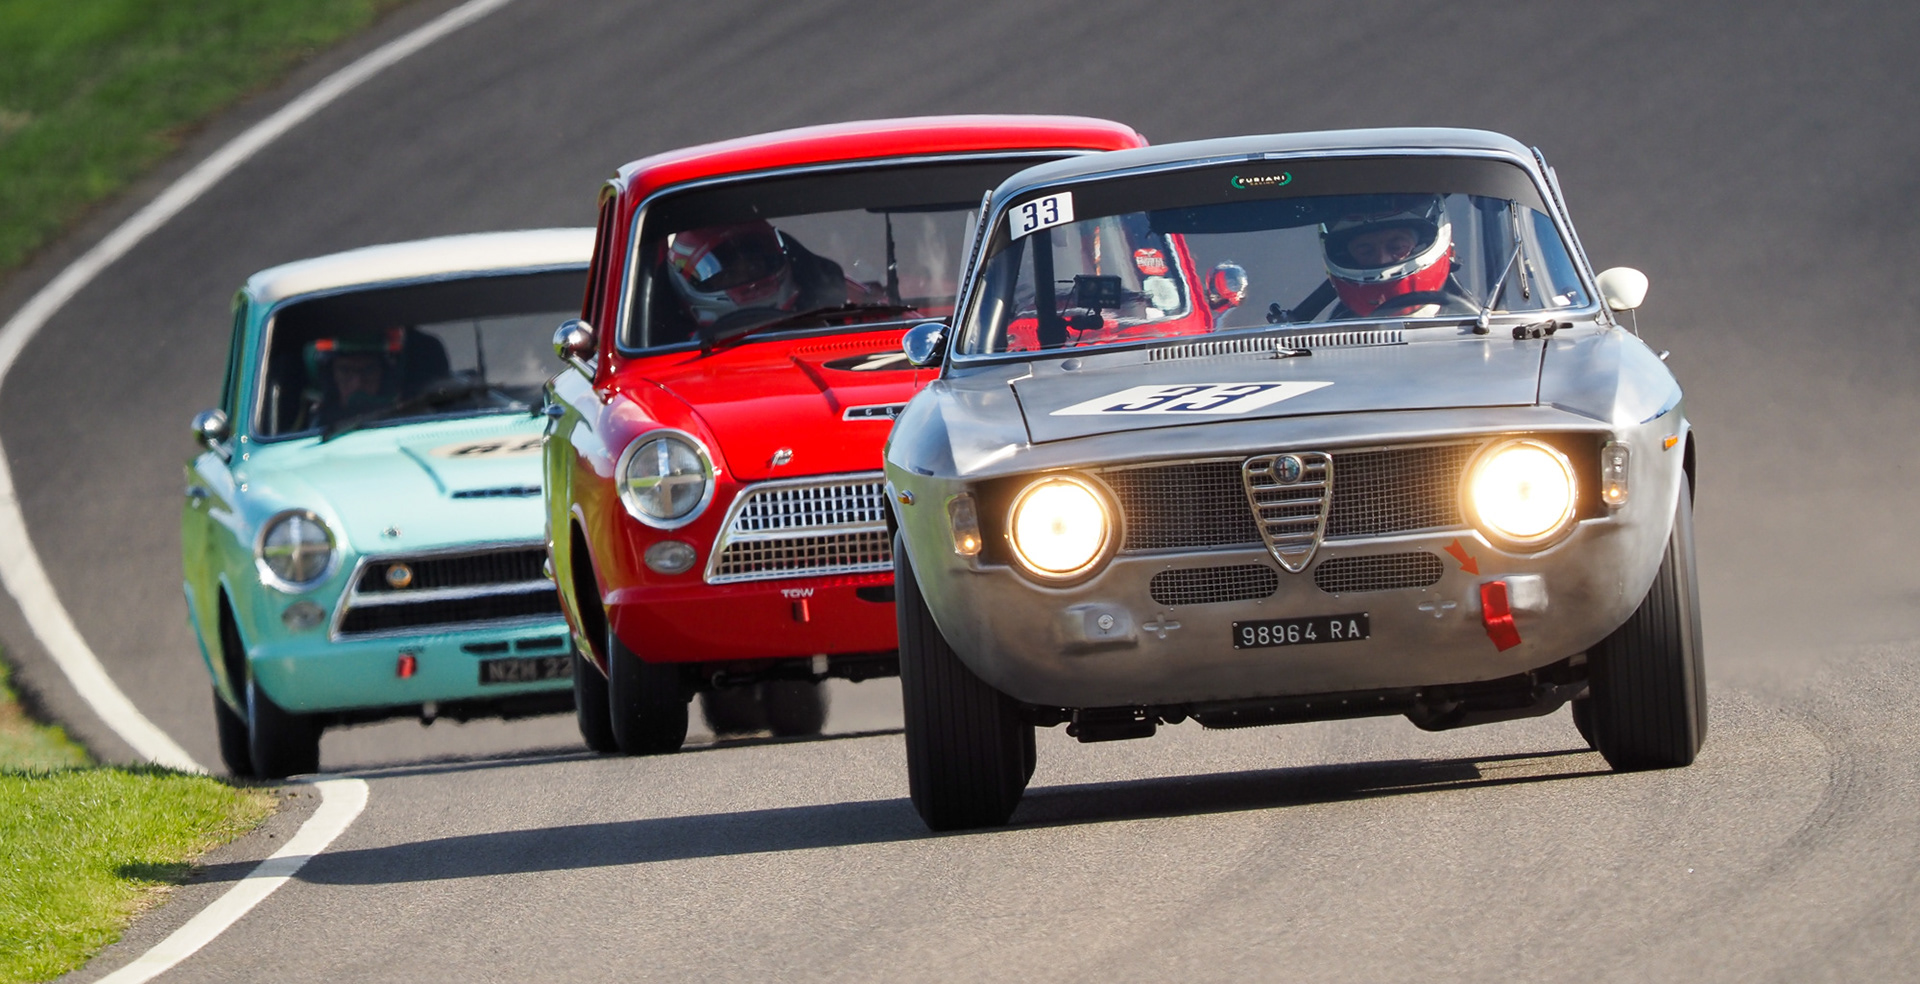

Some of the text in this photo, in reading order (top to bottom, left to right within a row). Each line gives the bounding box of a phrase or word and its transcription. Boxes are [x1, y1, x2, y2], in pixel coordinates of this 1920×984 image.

[1238, 175, 1285, 185] FURIANI
[1022, 197, 1059, 232] 33
[1102, 384, 1282, 412] 33
[780, 587, 814, 599] TOW
[1242, 620, 1360, 646] 98964 RA
